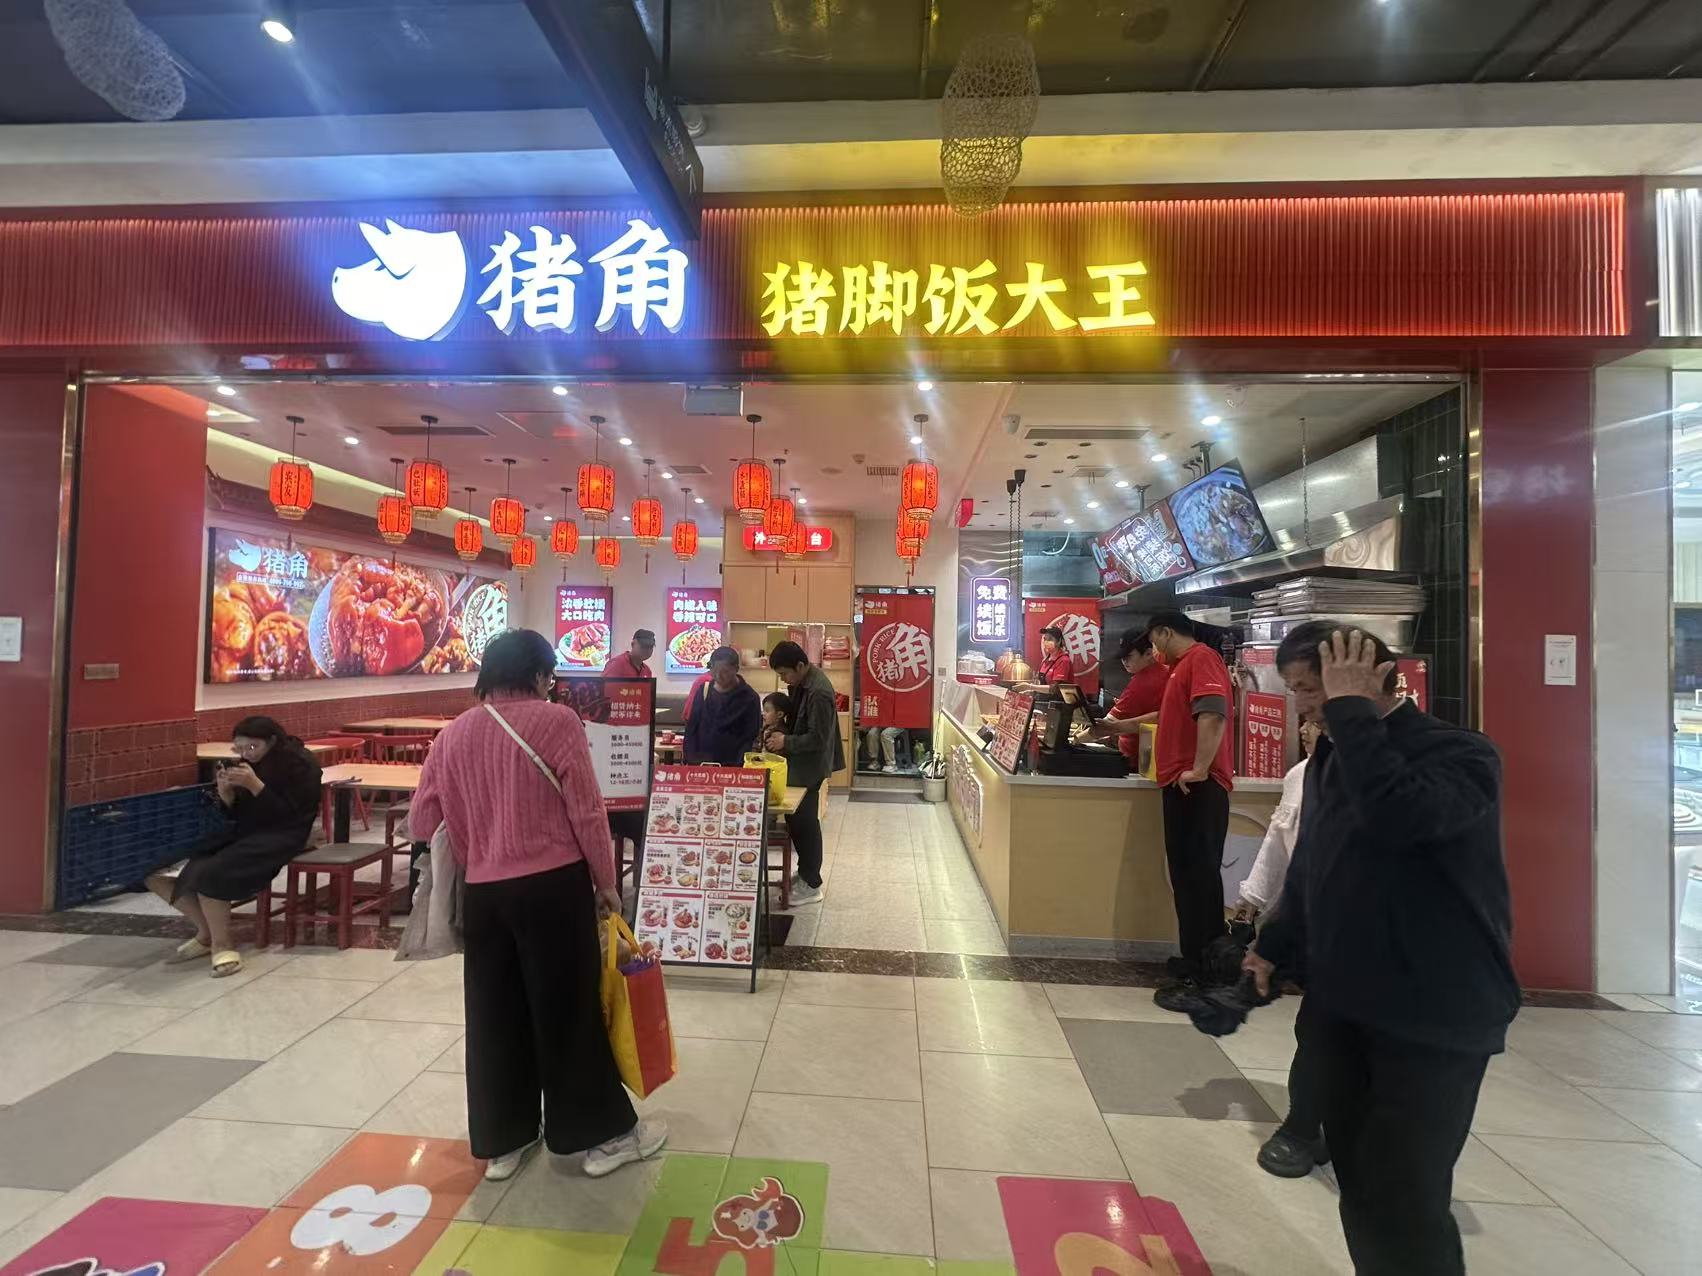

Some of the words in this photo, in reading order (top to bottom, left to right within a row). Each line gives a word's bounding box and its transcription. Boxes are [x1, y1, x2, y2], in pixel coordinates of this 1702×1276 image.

[477, 219, 690, 334] 猪角
[760, 259, 1156, 337] 猪脚饭大王
[262, 546, 308, 578] 猪角
[976, 584, 1007, 600] 免费
[561, 610, 605, 622] 大口吃肉
